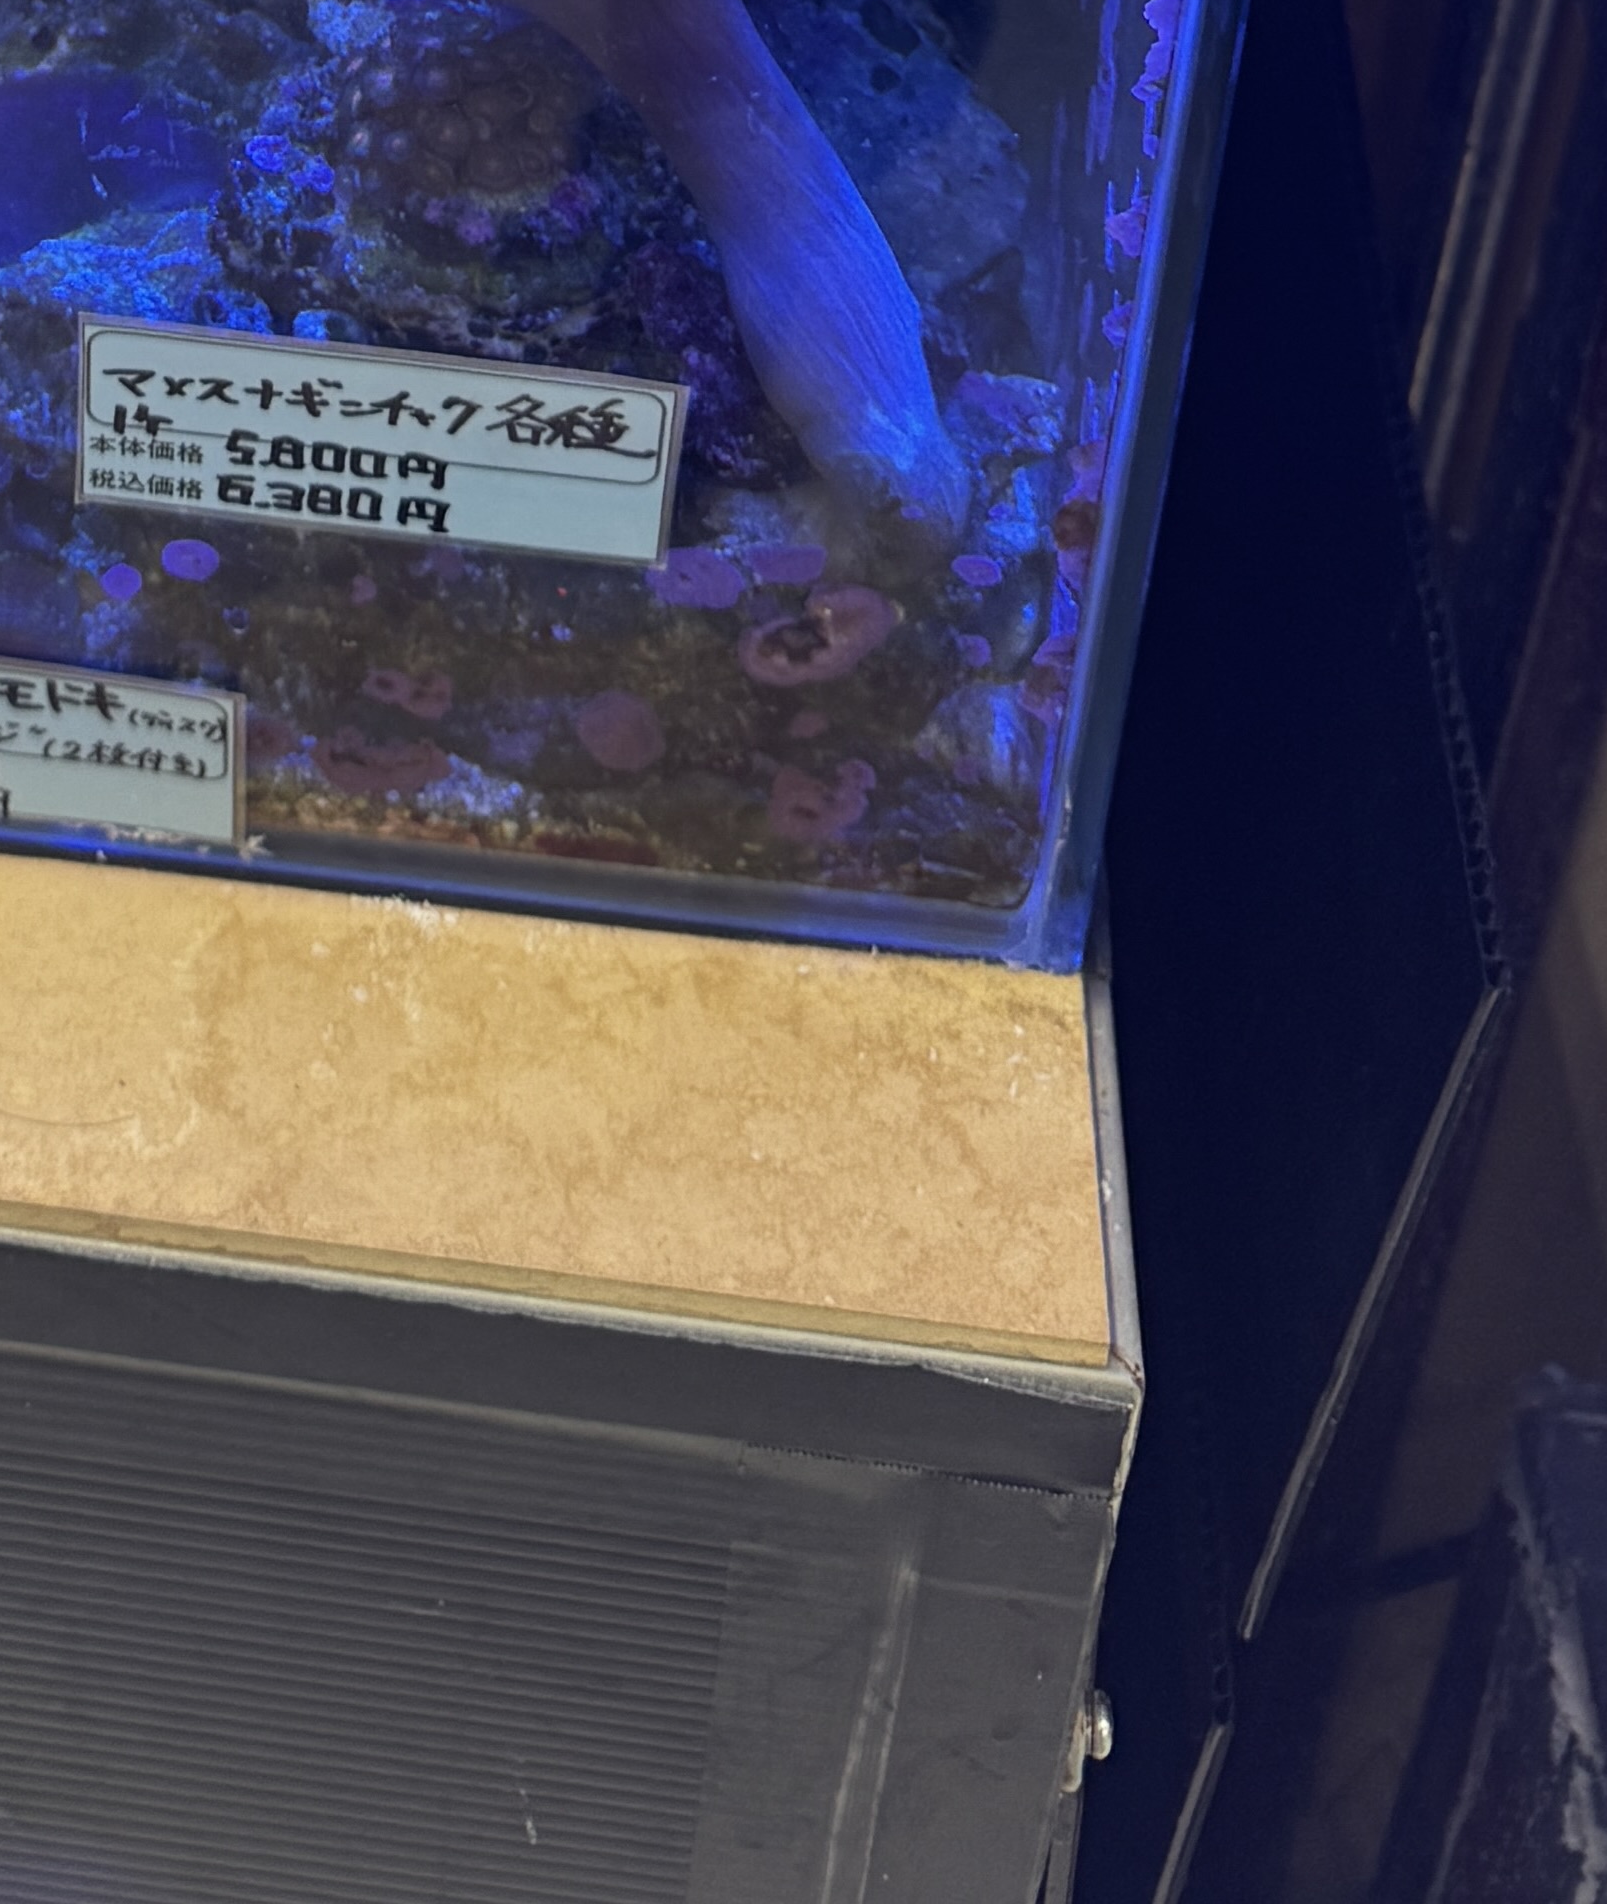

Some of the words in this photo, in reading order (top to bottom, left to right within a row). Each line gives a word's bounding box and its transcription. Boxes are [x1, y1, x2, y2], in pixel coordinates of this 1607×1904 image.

[89, 435, 204, 464] 本体価格
[89, 468, 203, 500] 税込価格
